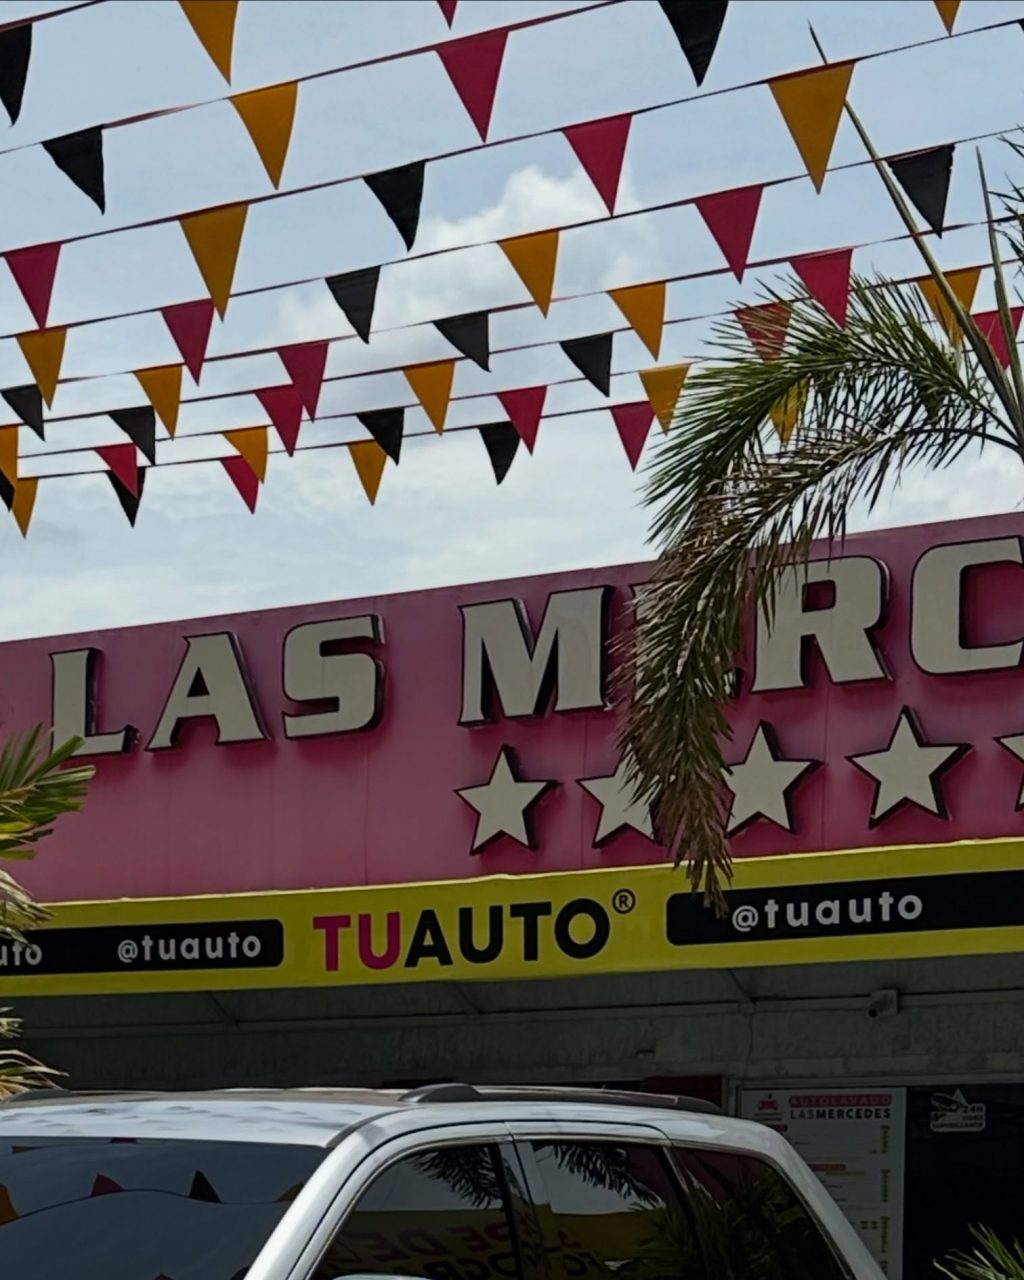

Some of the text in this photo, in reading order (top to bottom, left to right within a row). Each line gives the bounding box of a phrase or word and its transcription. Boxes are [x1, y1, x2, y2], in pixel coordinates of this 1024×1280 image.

[49, 535, 1024, 756] LAS MRC
[731, 891, 923, 932] @tuauto
[117, 931, 262, 963] @tuauto
